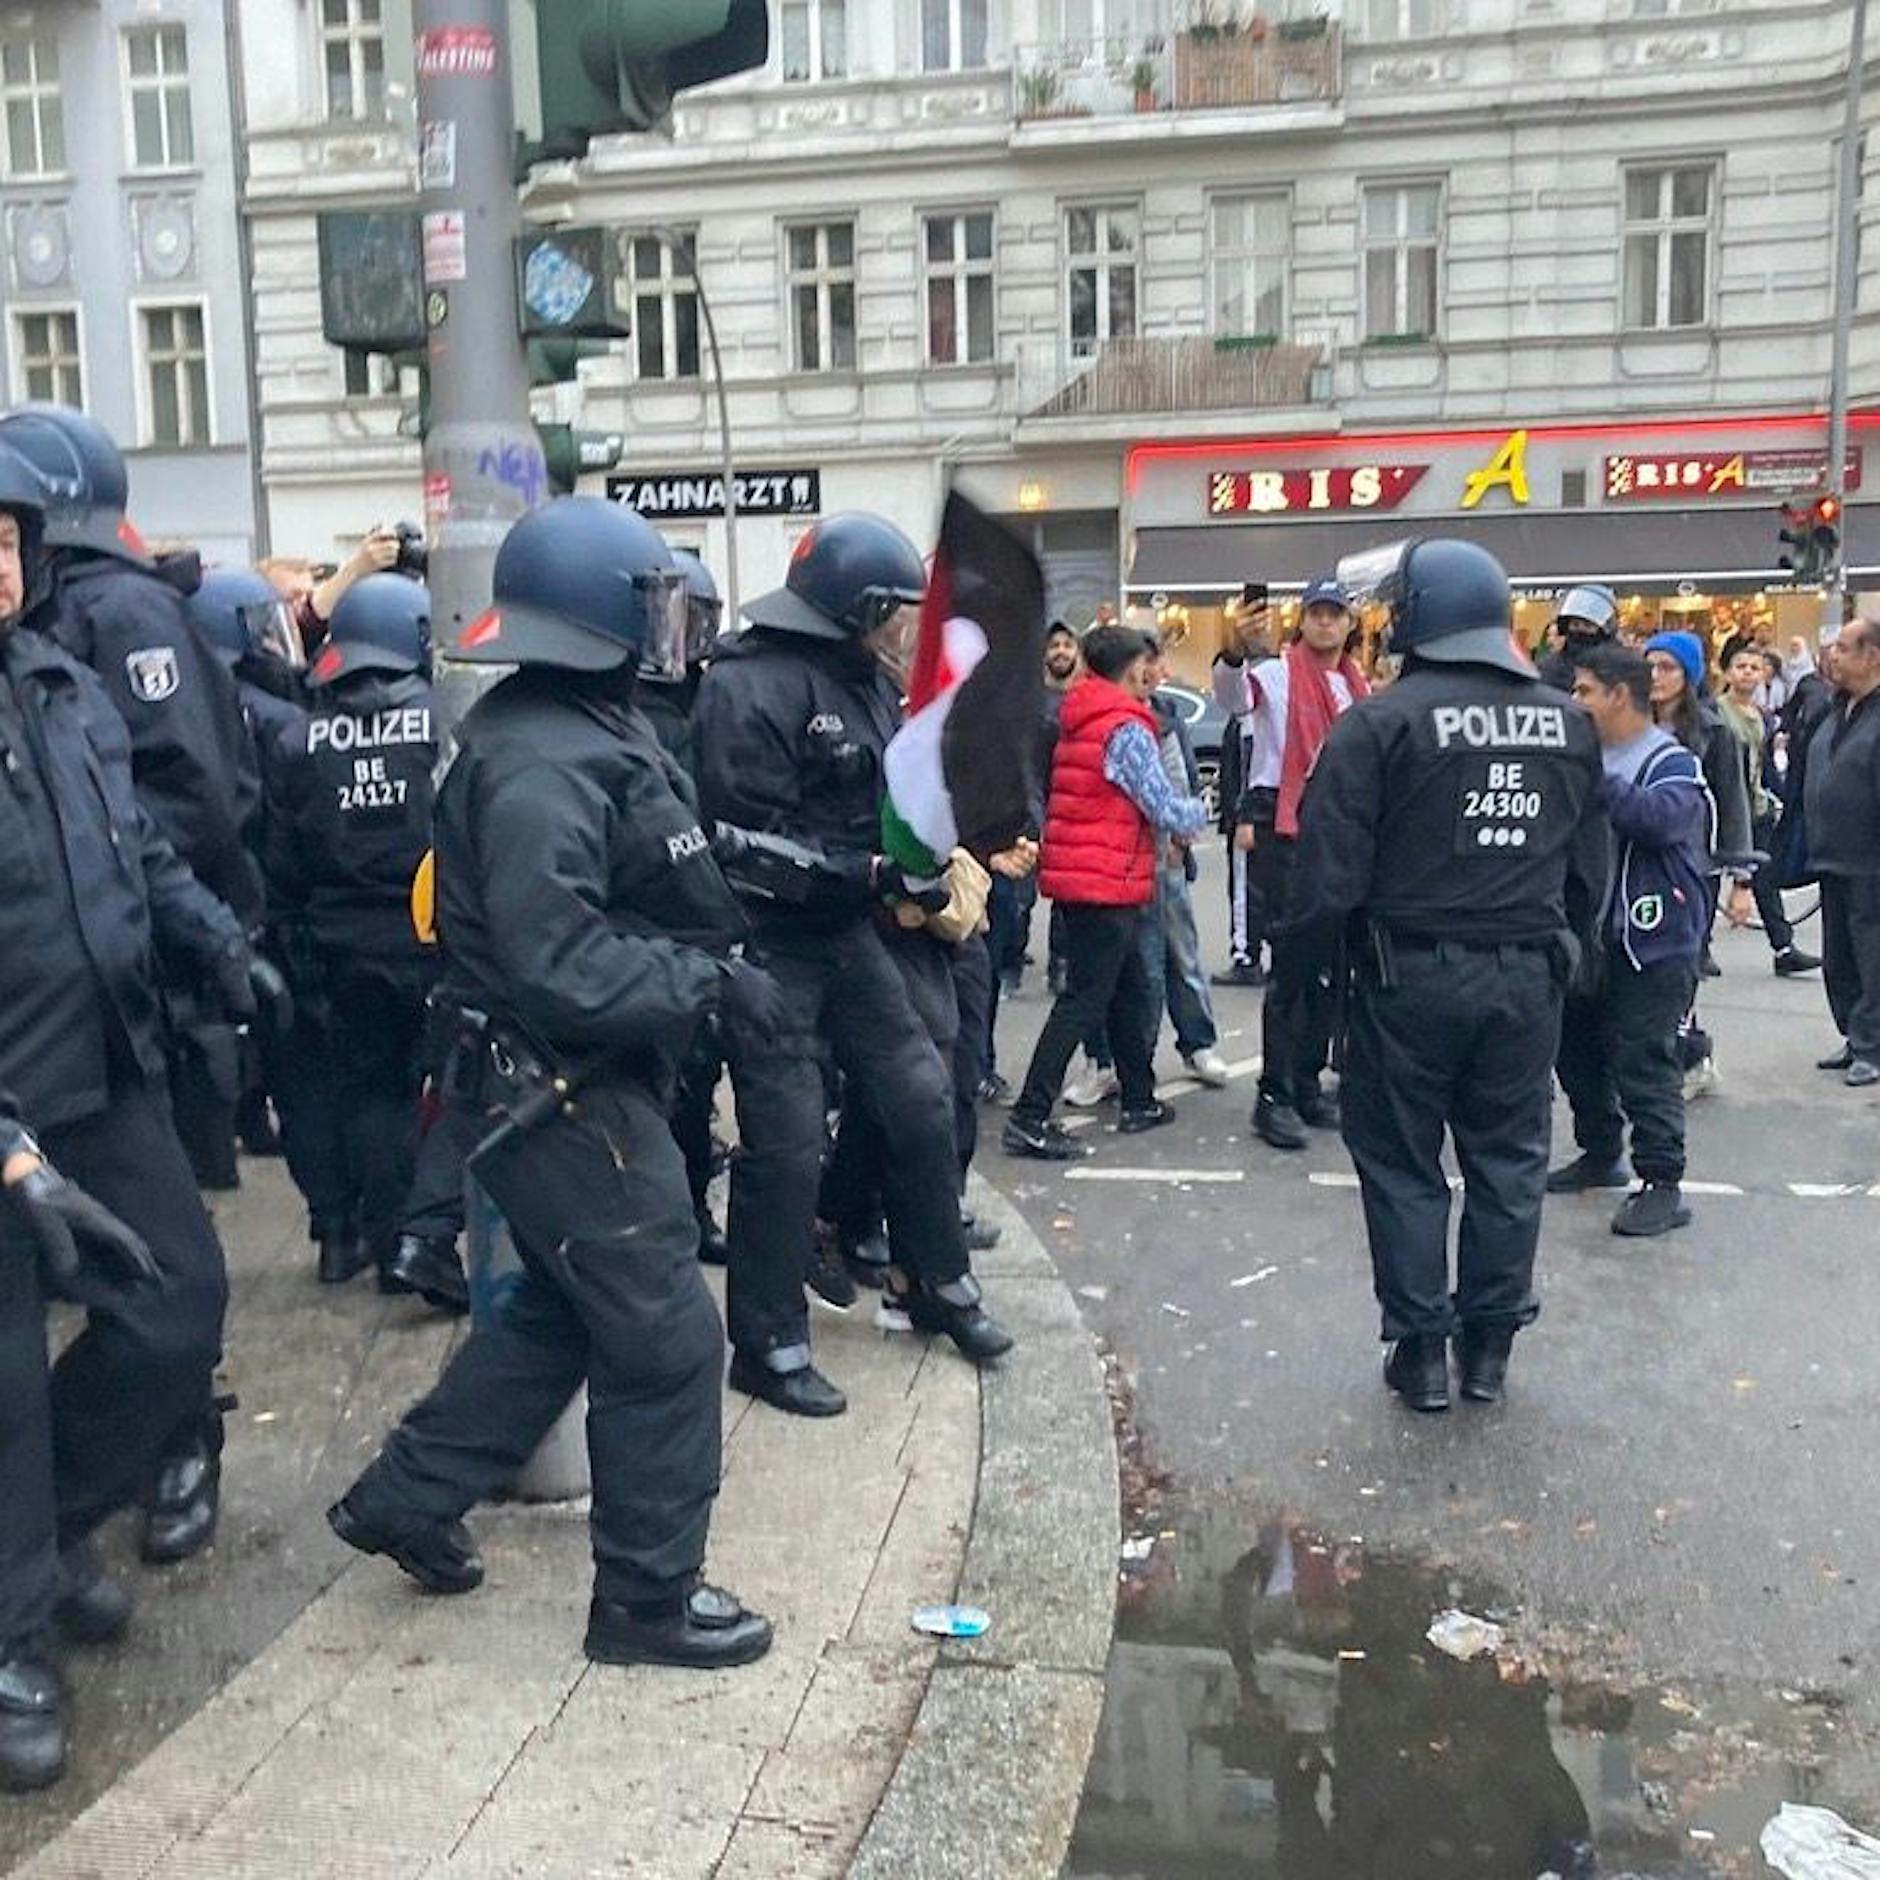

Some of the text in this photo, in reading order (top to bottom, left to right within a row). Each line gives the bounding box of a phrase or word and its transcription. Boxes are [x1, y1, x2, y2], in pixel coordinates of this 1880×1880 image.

[614, 477, 789, 511] ZAHNARZT
[307, 708, 430, 754] POLIZEI
[1433, 705, 1567, 748] POLIZEI
[353, 757, 386, 783] BE
[1488, 763, 1523, 789] BE
[337, 780, 407, 811] 24127
[1464, 791, 1541, 818] 24300
